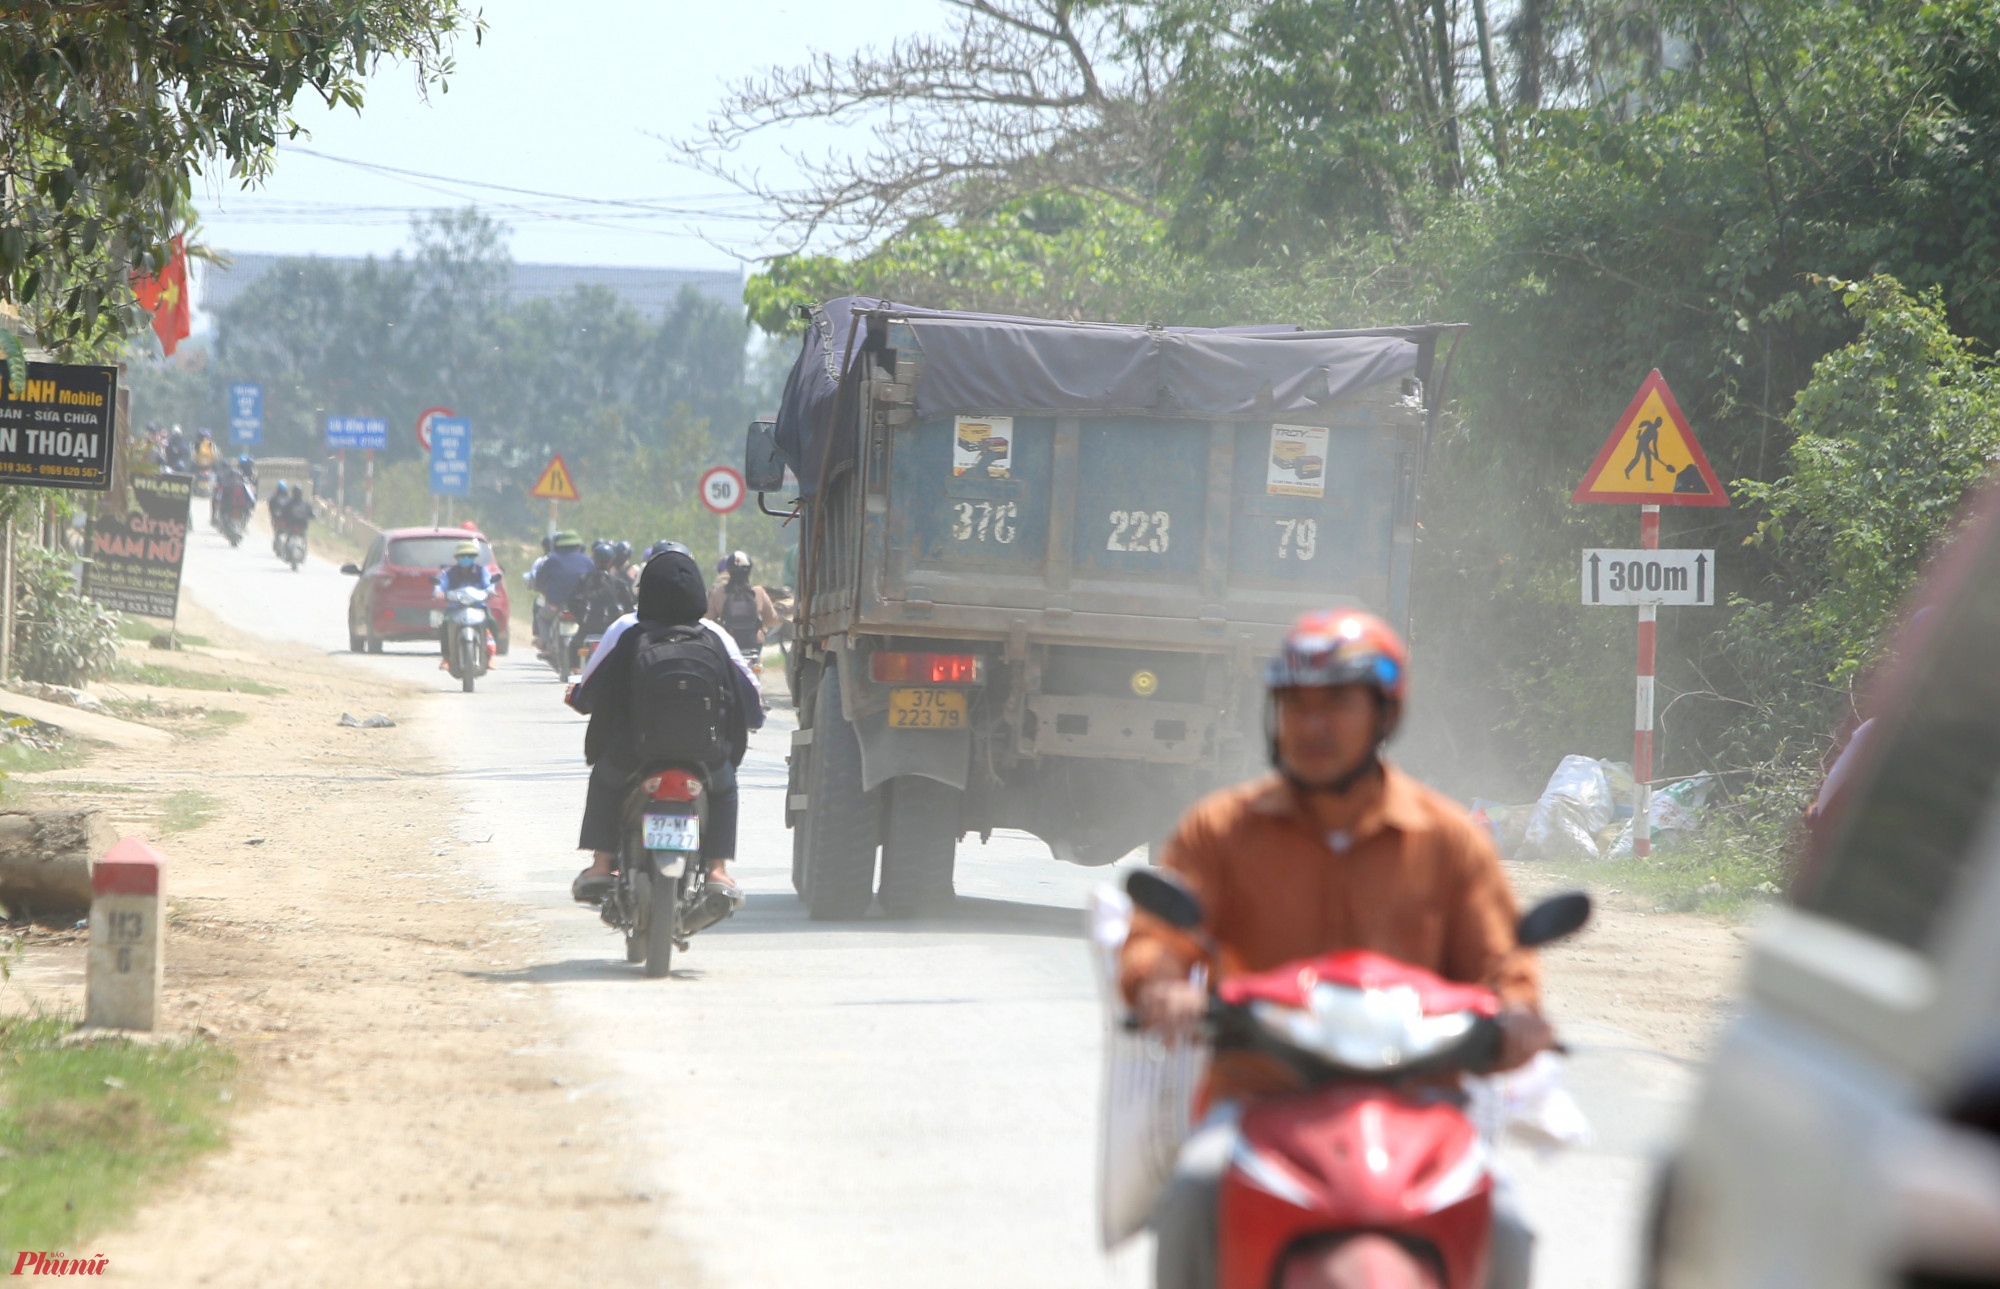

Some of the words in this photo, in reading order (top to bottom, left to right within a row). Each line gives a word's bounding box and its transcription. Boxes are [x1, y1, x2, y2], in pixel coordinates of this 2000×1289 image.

[59, 389, 103, 406] Mobile
[711, 482, 731, 500] 50
[1107, 510, 1169, 553] 223
[1275, 518, 1316, 560] 79
[93, 531, 145, 558] NAM
[1609, 561, 1688, 591] 300m
[911, 690, 945, 708] 37C
[897, 709, 959, 727] 223.79
